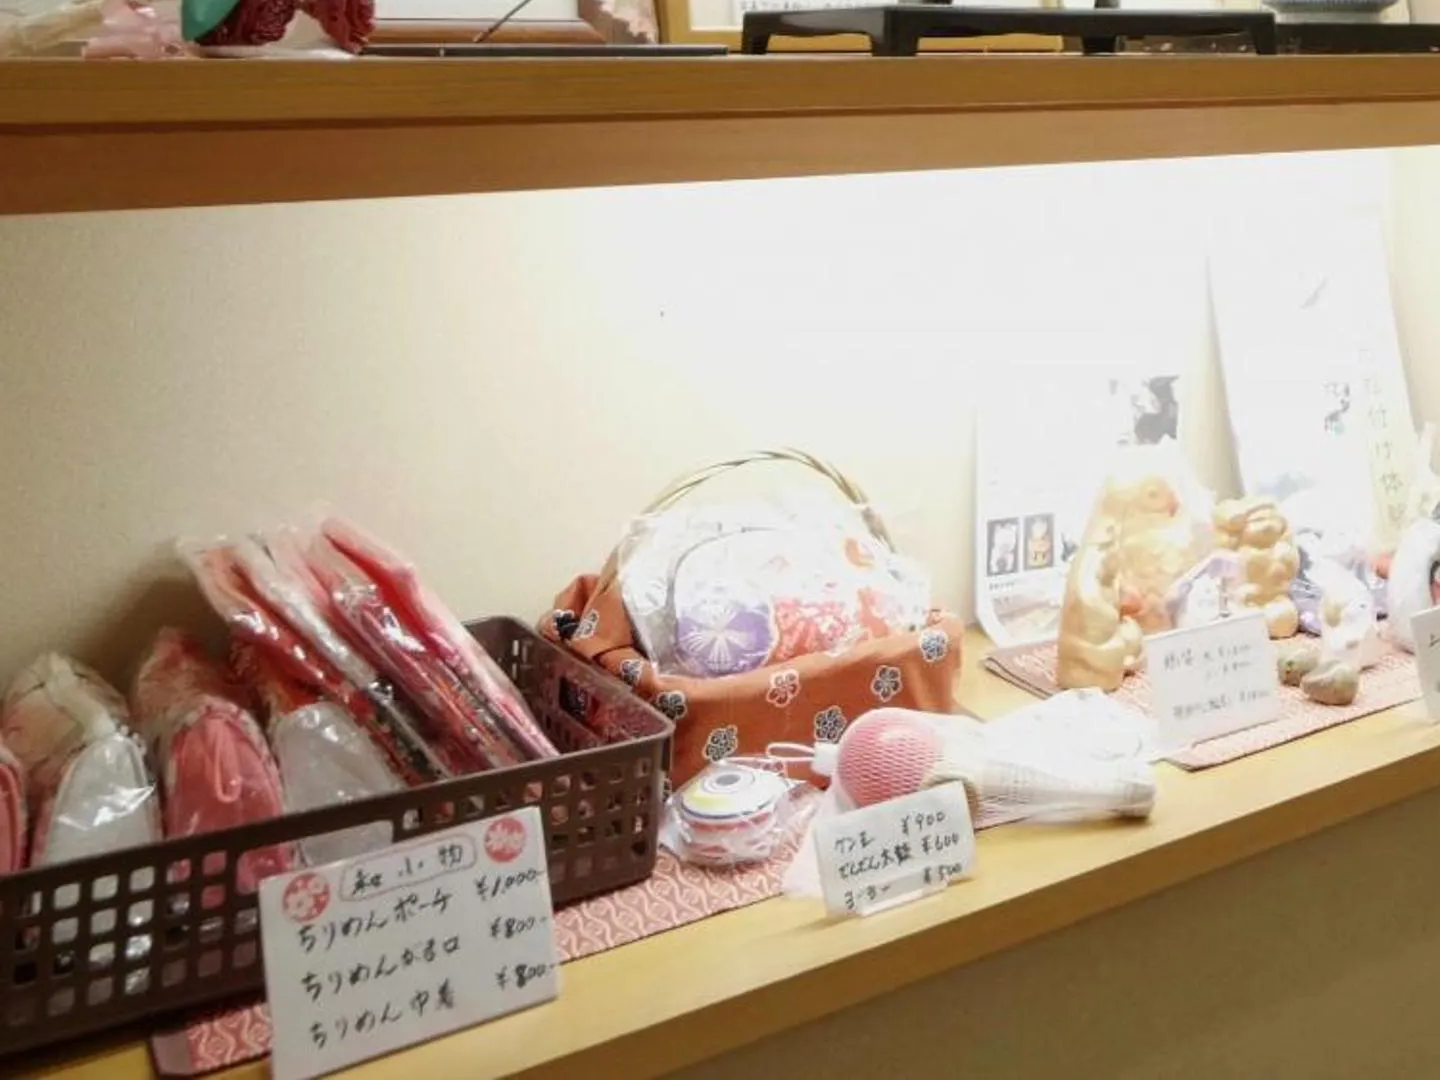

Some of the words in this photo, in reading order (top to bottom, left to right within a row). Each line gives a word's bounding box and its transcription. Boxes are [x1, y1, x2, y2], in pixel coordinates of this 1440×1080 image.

[900, 811, 947, 836] ¥900
[921, 832, 960, 855] ¥600
[298, 887, 454, 954] ちりめんポーチ
